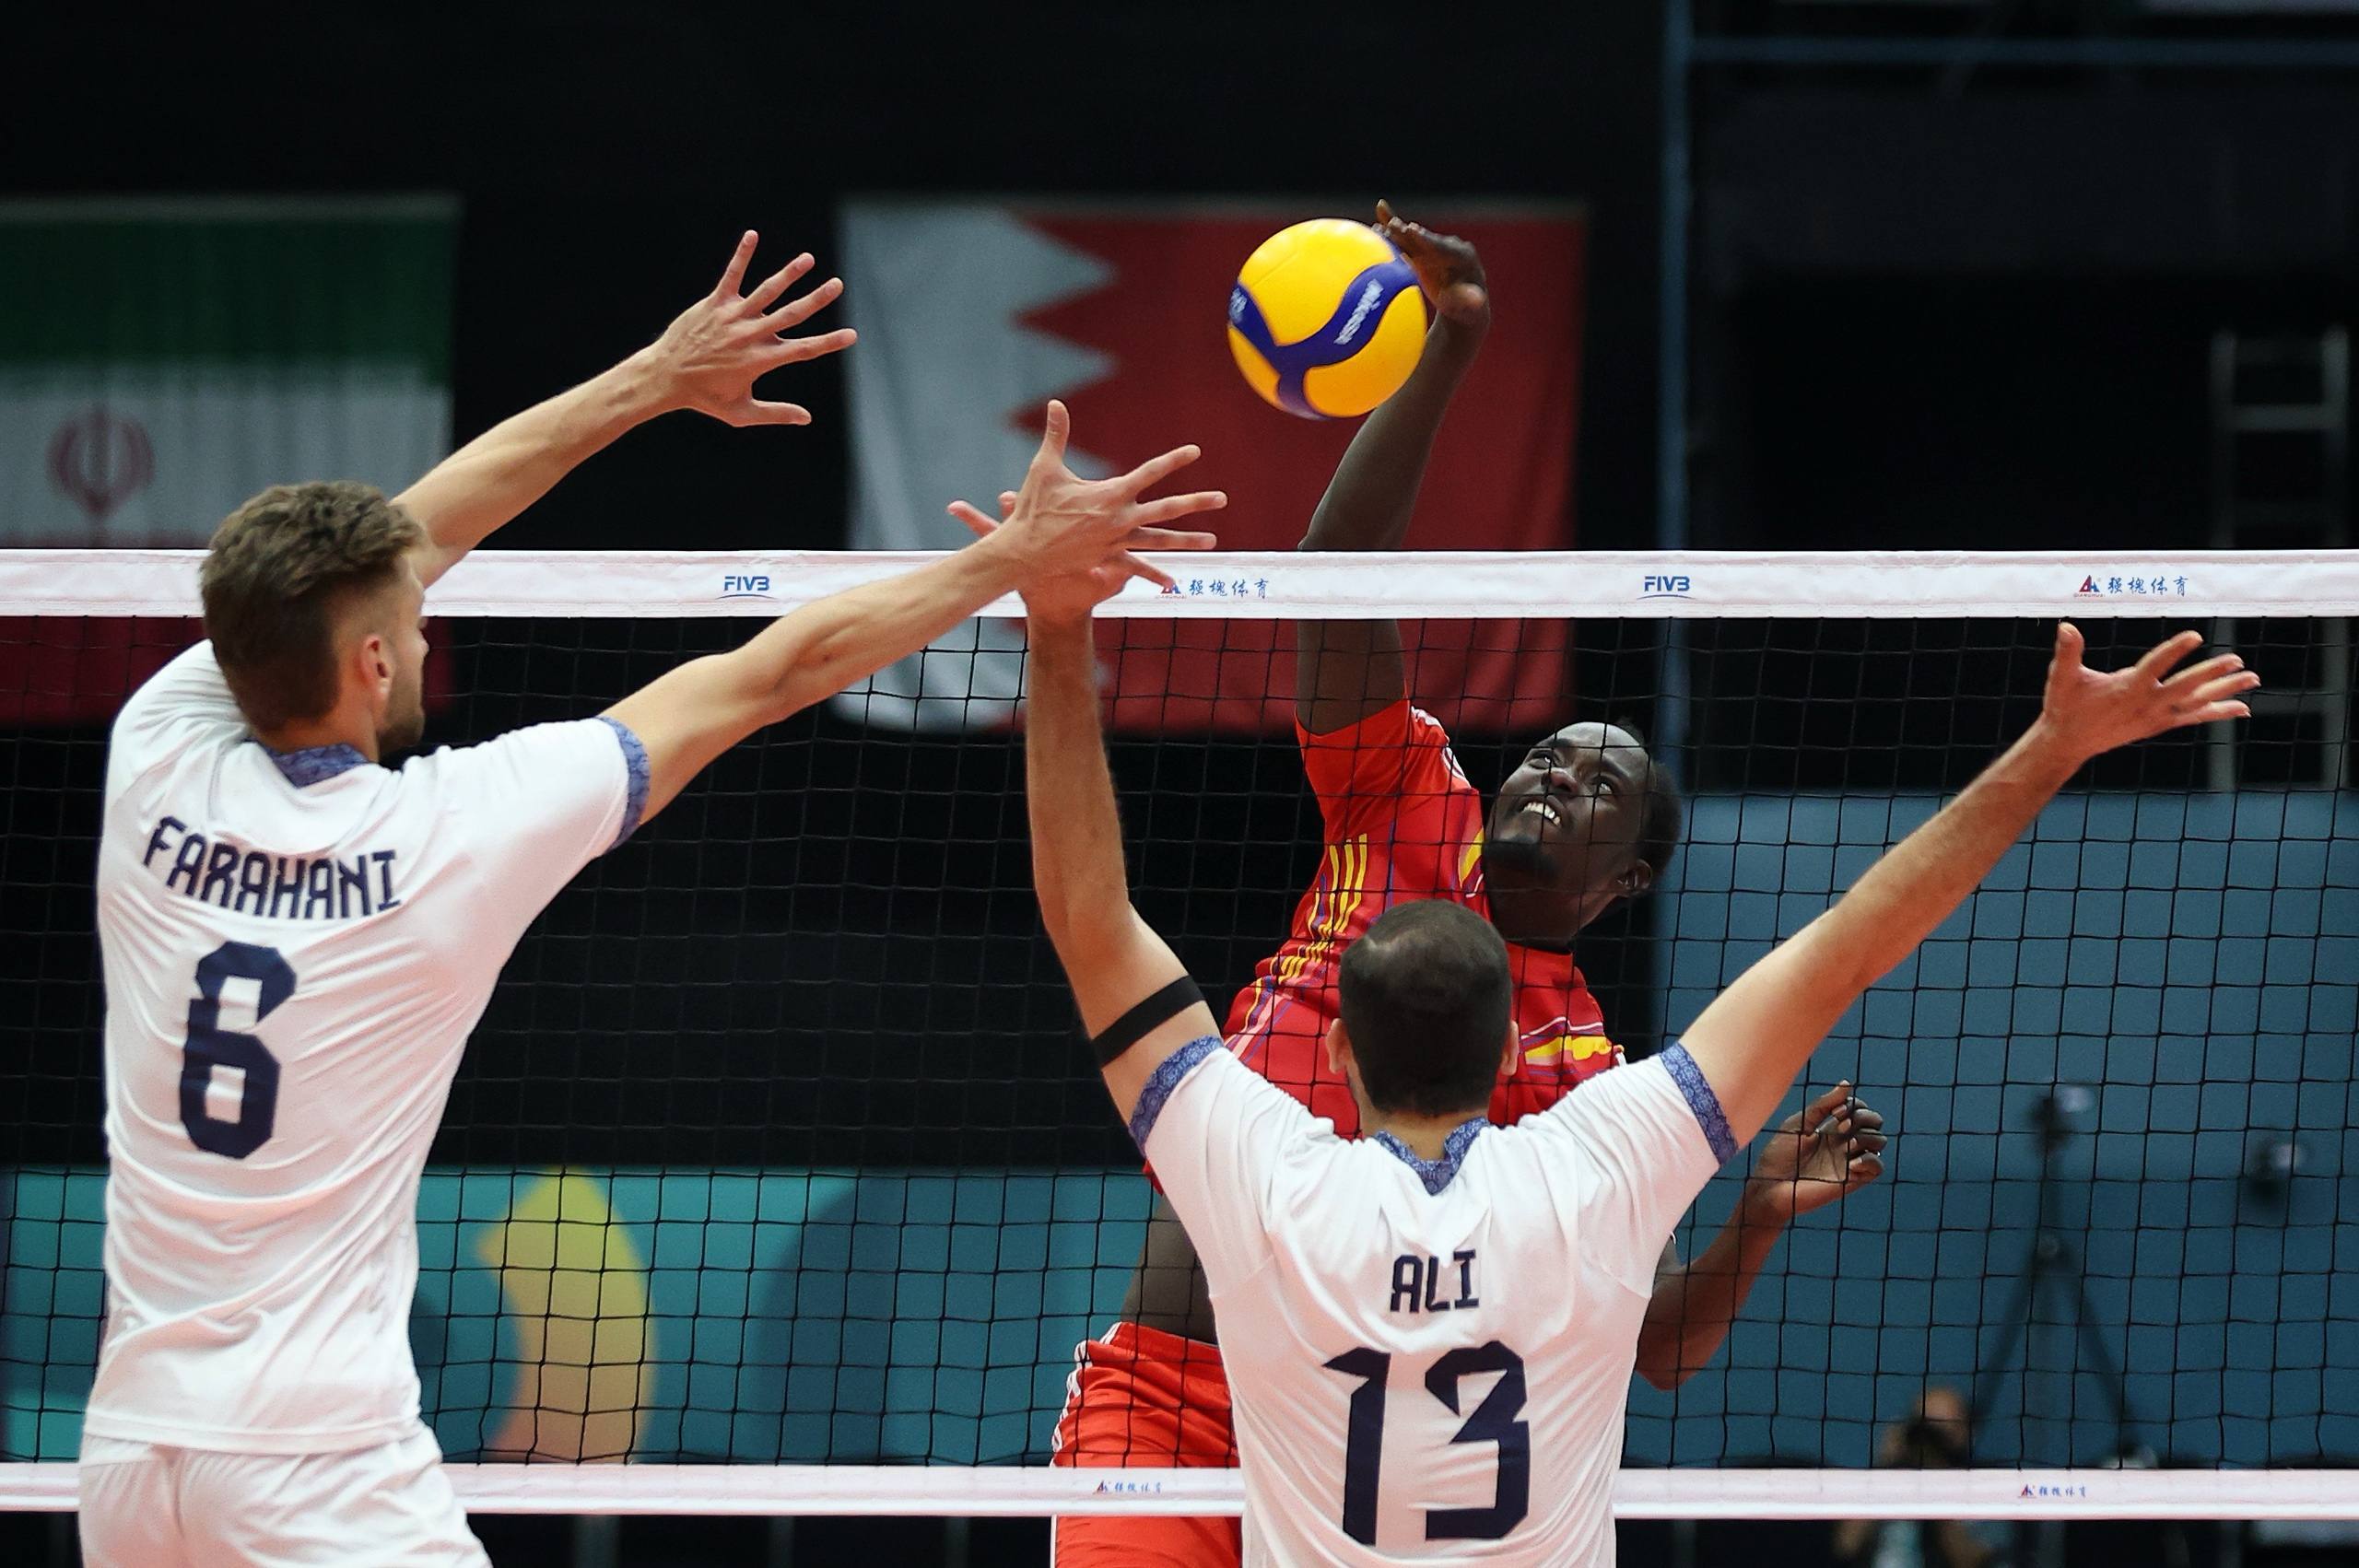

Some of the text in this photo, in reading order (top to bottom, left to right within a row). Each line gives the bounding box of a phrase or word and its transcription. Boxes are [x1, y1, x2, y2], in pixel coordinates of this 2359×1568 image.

[724, 576, 769, 591] FIVB
[1645, 576, 1690, 591] FIVB
[143, 815, 403, 919] FARAHANI
[179, 941, 297, 1159] 6
[1390, 1249, 1479, 1313] ALI
[1321, 1340, 1530, 1547] 13
